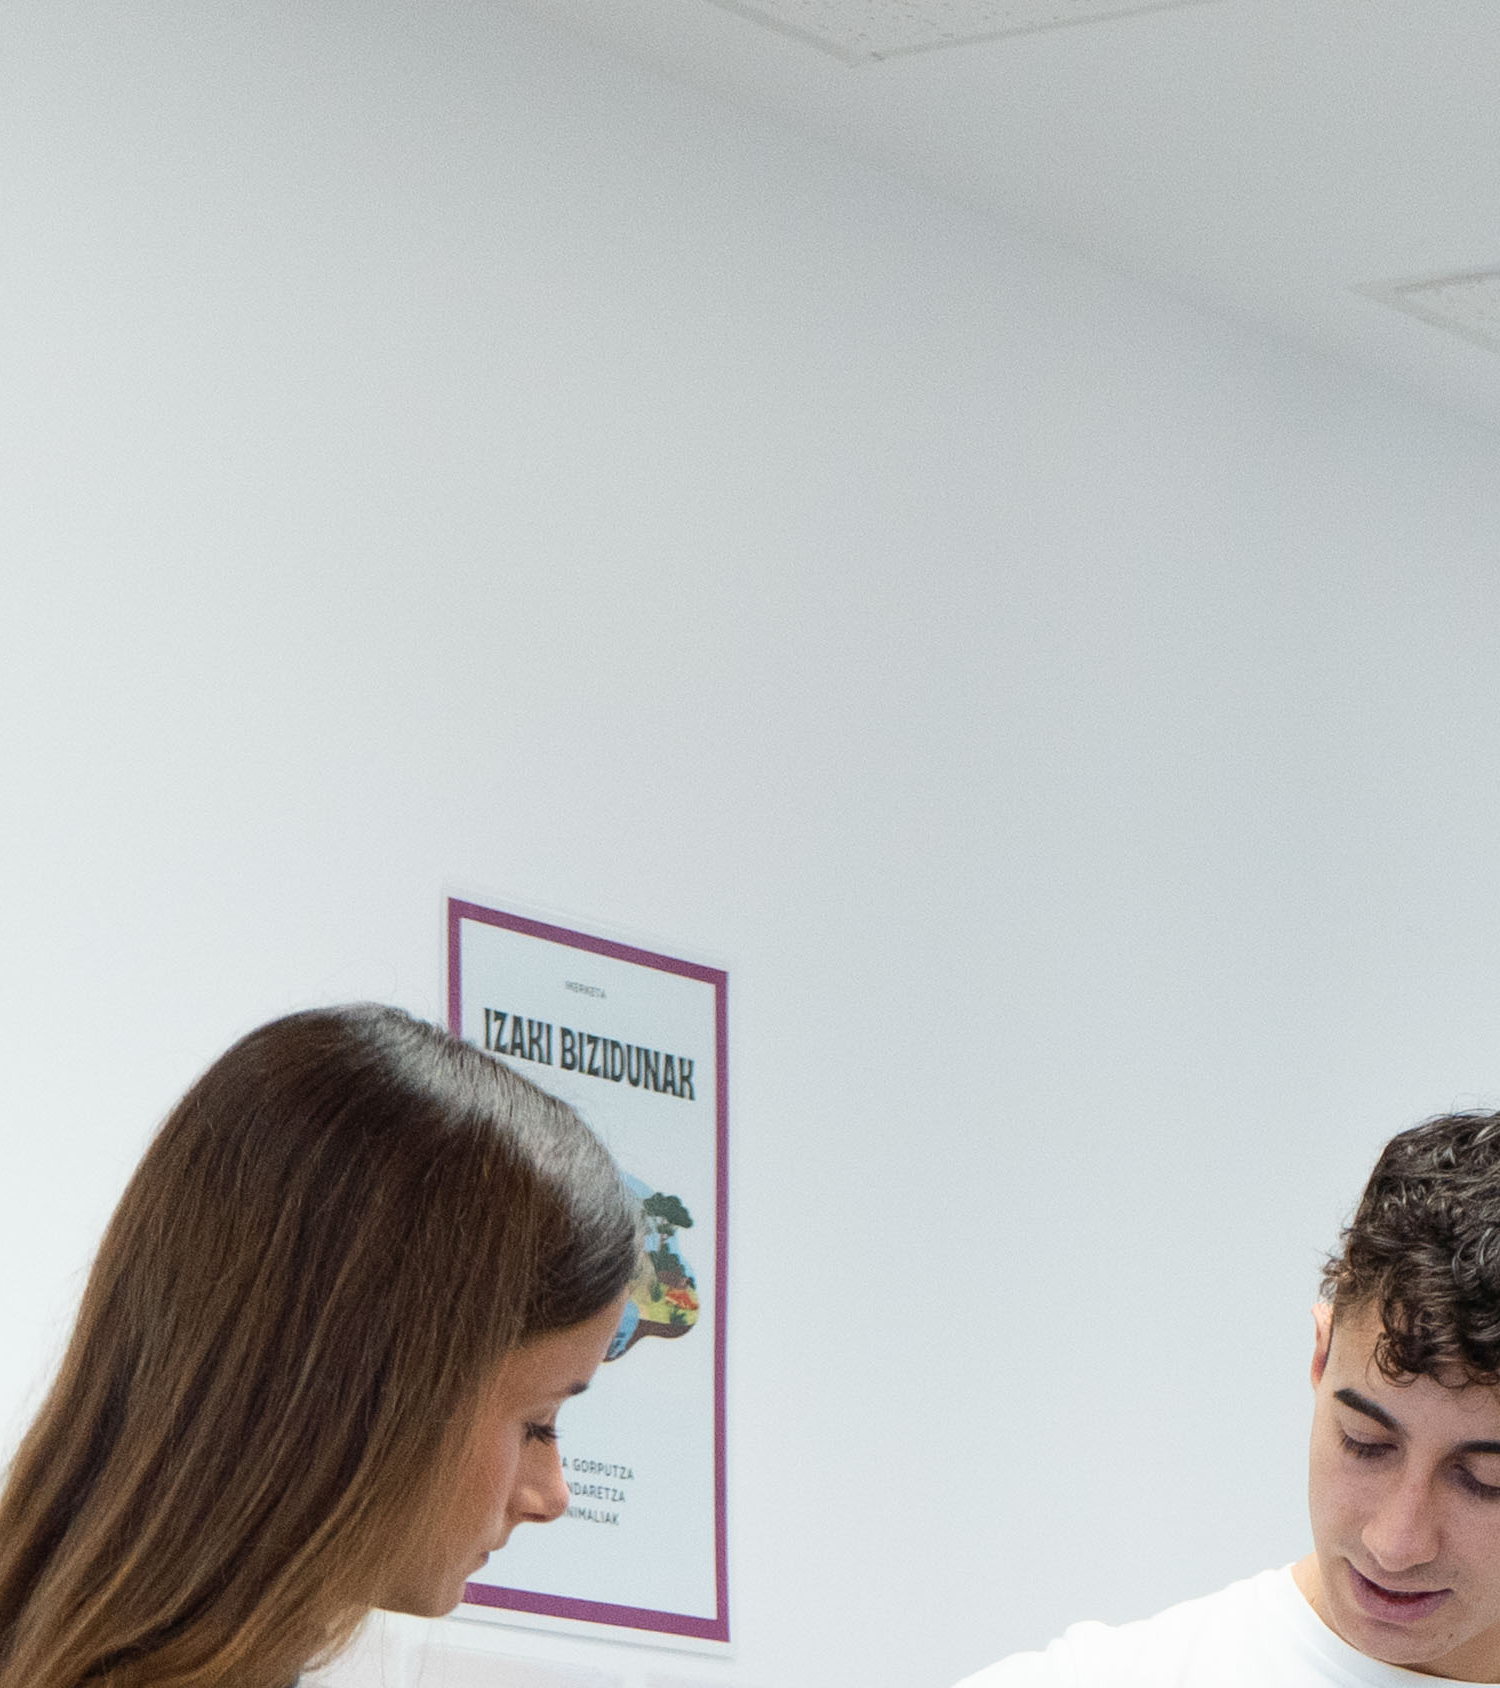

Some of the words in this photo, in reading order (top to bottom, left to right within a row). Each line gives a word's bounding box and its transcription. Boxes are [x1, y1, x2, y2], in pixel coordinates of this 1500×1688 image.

[483, 1006, 553, 1066] IZAKI
[559, 1025, 696, 1101] BIZIDUNAK
[573, 1457, 634, 1480] GORPUTZA
[566, 1481, 626, 1503] NDARETZA
[565, 1506, 620, 1526] NIMALIAK
